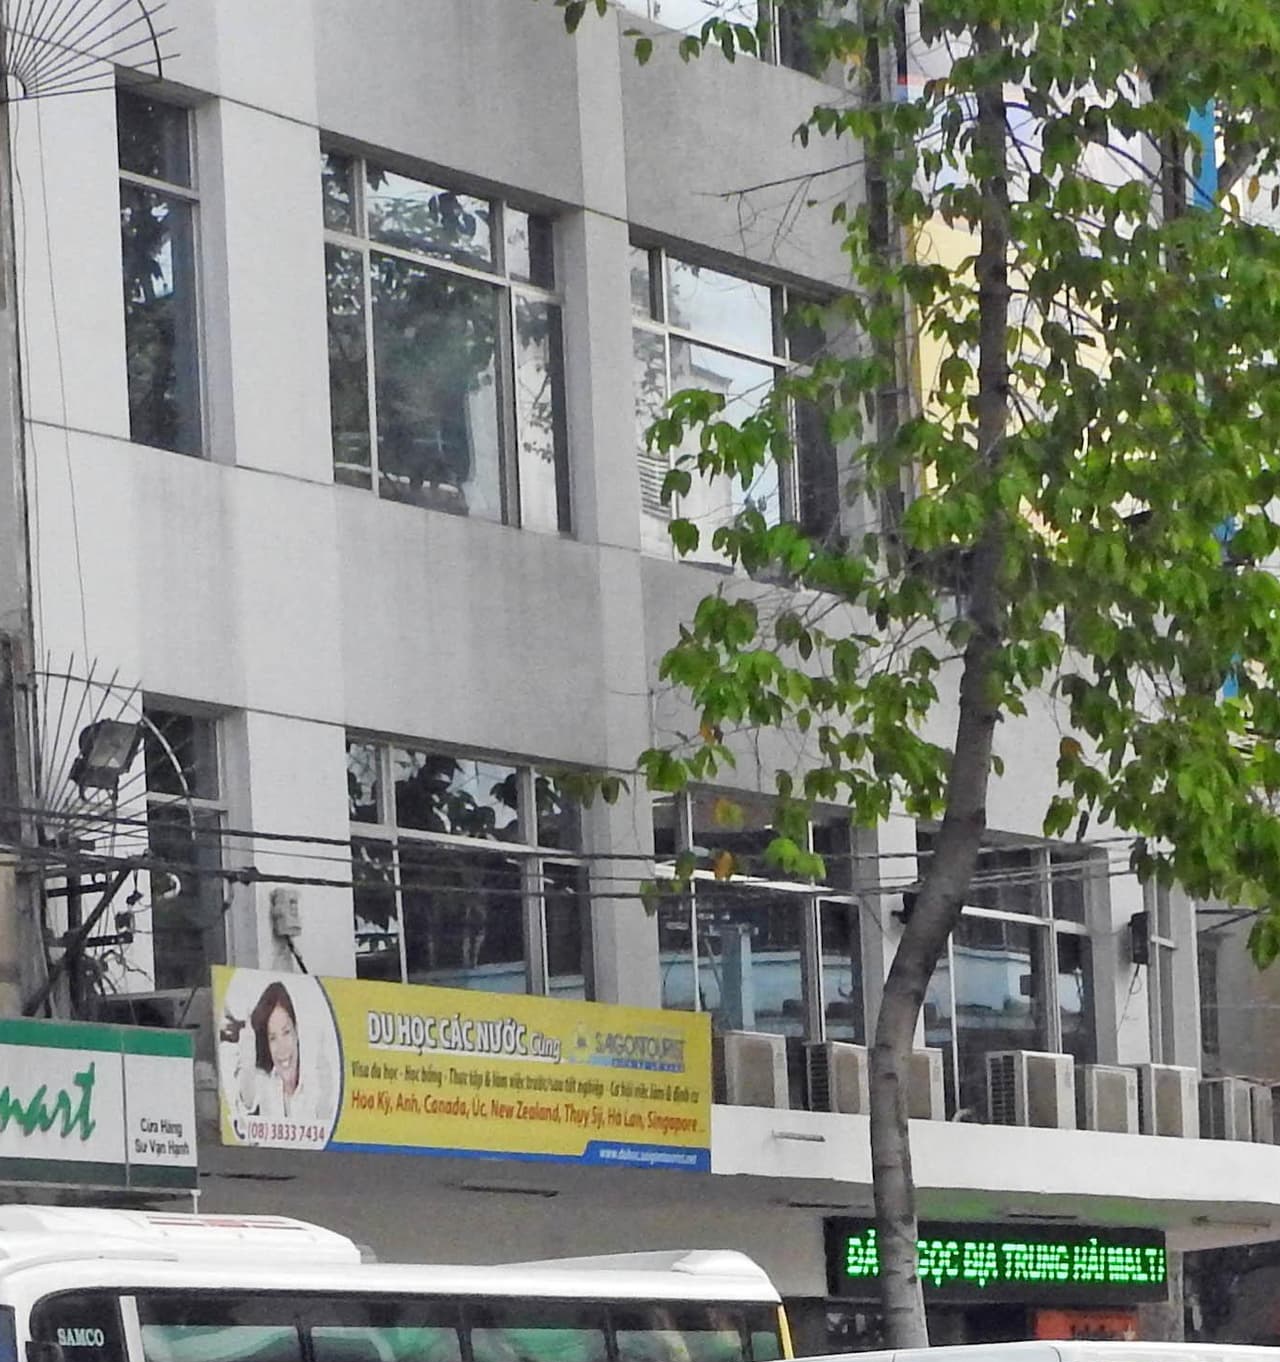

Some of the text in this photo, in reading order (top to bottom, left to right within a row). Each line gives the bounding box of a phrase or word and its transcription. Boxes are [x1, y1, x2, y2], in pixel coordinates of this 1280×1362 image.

[368, 1010, 395, 1045] DU
[397, 1014, 436, 1056] HỌC
[439, 1012, 474, 1051] CÁC
[476, 1016, 528, 1056] NƯỚC
[56, 1326, 105, 1348] SAMCO
